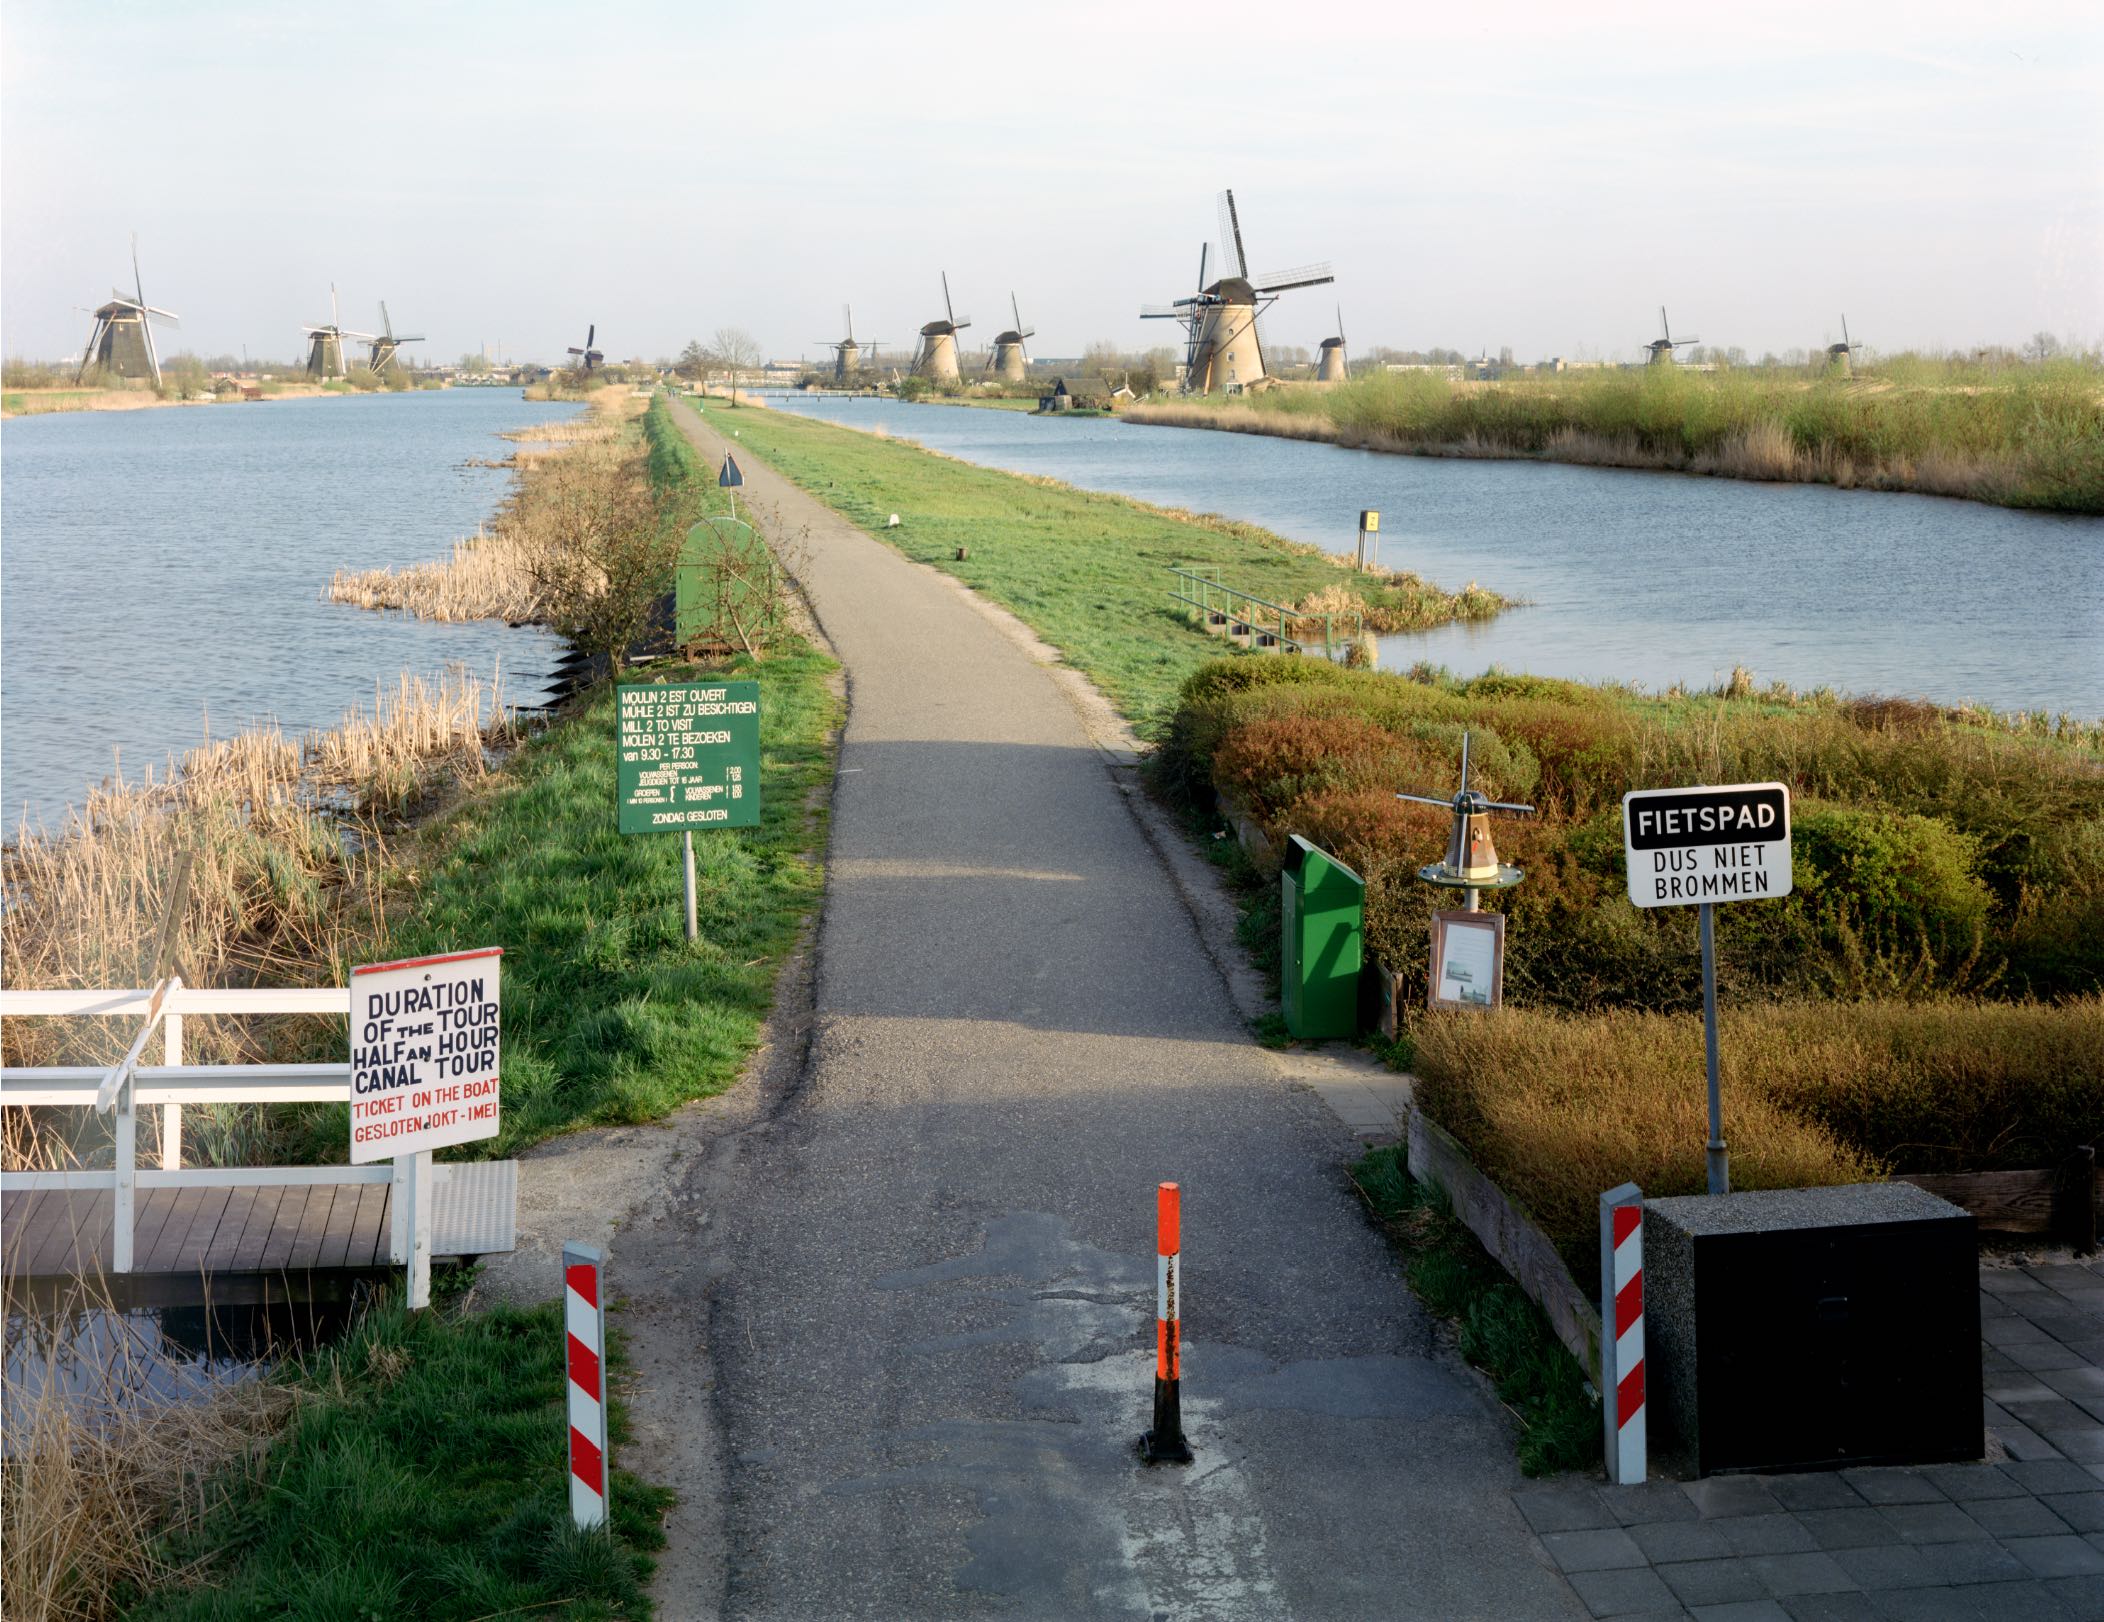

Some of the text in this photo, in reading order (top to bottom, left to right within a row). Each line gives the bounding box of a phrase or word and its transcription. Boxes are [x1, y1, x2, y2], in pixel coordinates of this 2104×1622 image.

[622, 689, 727, 705] MOULIN 2 EST OUVERT
[622, 702, 757, 719] MÜHLE 2 IST ZU BESICHTIGEN
[622, 719, 694, 733] MILL 2 TO VISIT
[622, 731, 731, 747] MOLEN 2 TE BEZOEKEN
[623, 752, 639, 762] van
[641, 748, 661, 761] 9.30
[672, 746, 694, 759] 17.30
[652, 809, 728, 824] ZONDAG GESLOTEN
[1638, 803, 1776, 837] FIETSPAD
[1653, 844, 1766, 873] DUS NIET
[1655, 870, 1768, 900] BROMMEN
[368, 978, 484, 1020] DURATION
[363, 1002, 499, 1044] OF THE TOUR
[353, 1025, 499, 1071] HALF AN HOUR
[355, 1049, 495, 1095] CANAL TOUR
[352, 1077, 499, 1119] TICKET ON THE BOAT
[355, 1116, 422, 1143] GESLOTEN
